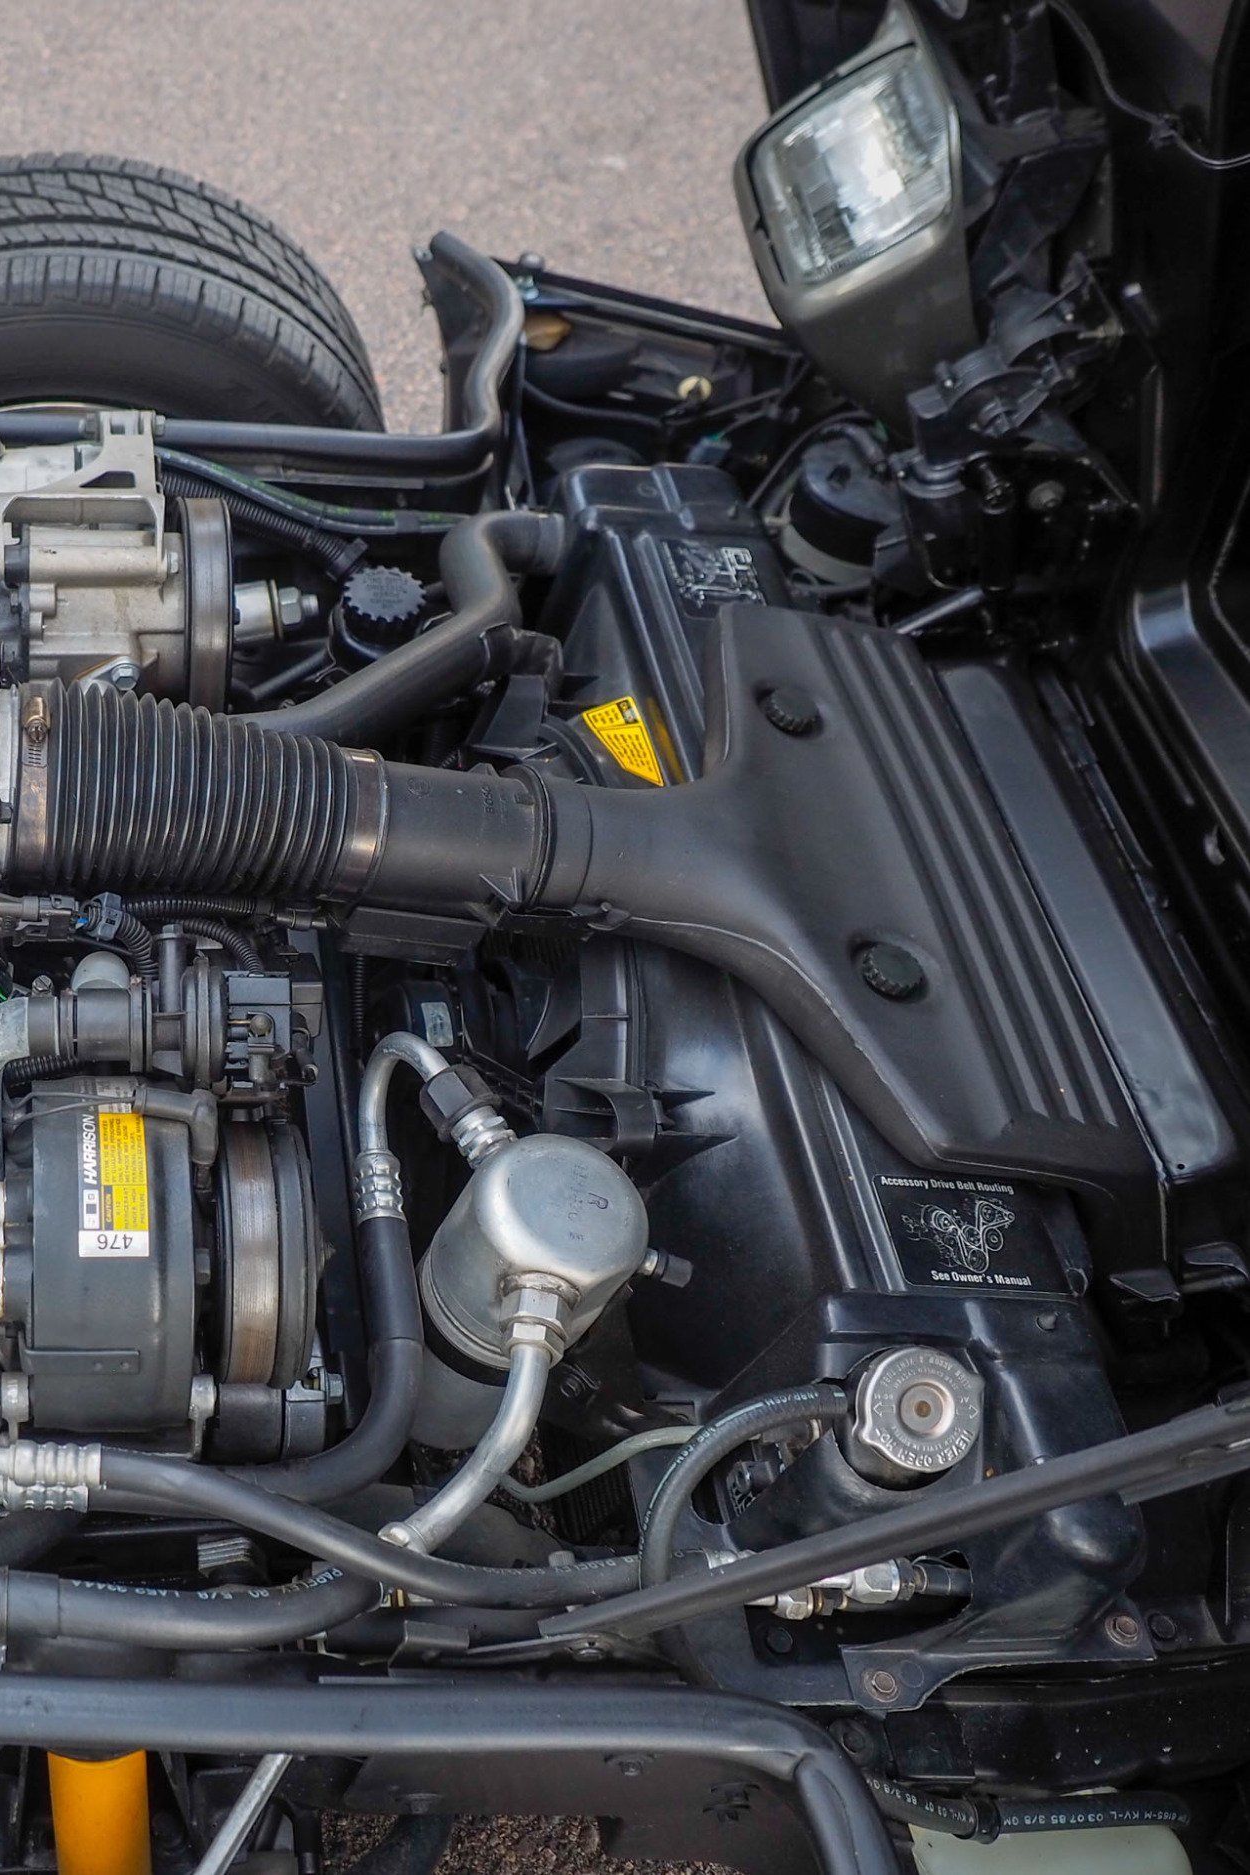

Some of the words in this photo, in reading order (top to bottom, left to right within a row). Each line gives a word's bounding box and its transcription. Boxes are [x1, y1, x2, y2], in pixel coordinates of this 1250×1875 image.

[81, 1114, 98, 1185] HARRISON
[881, 1176, 929, 1190] Accessory
[930, 1179, 956, 1190] Drive
[957, 1181, 976, 1191] Belt
[977, 1183, 1015, 1196] Routing
[97, 1233, 134, 1250] 476
[931, 1269, 951, 1281] See
[952, 1271, 993, 1285] Owner's
[995, 1274, 1033, 1287] Manual
[936, 1429, 974, 1465] NEVER
[897, 1448, 934, 1468] OPEN
[1024, 1814, 1046, 1825] 3/8
[1051, 1814, 1067, 1825] 85
[1070, 1814, 1085, 1824] 07
[1088, 1813, 1104, 1823] 03
[1110, 1810, 1139, 1820] KV-L
